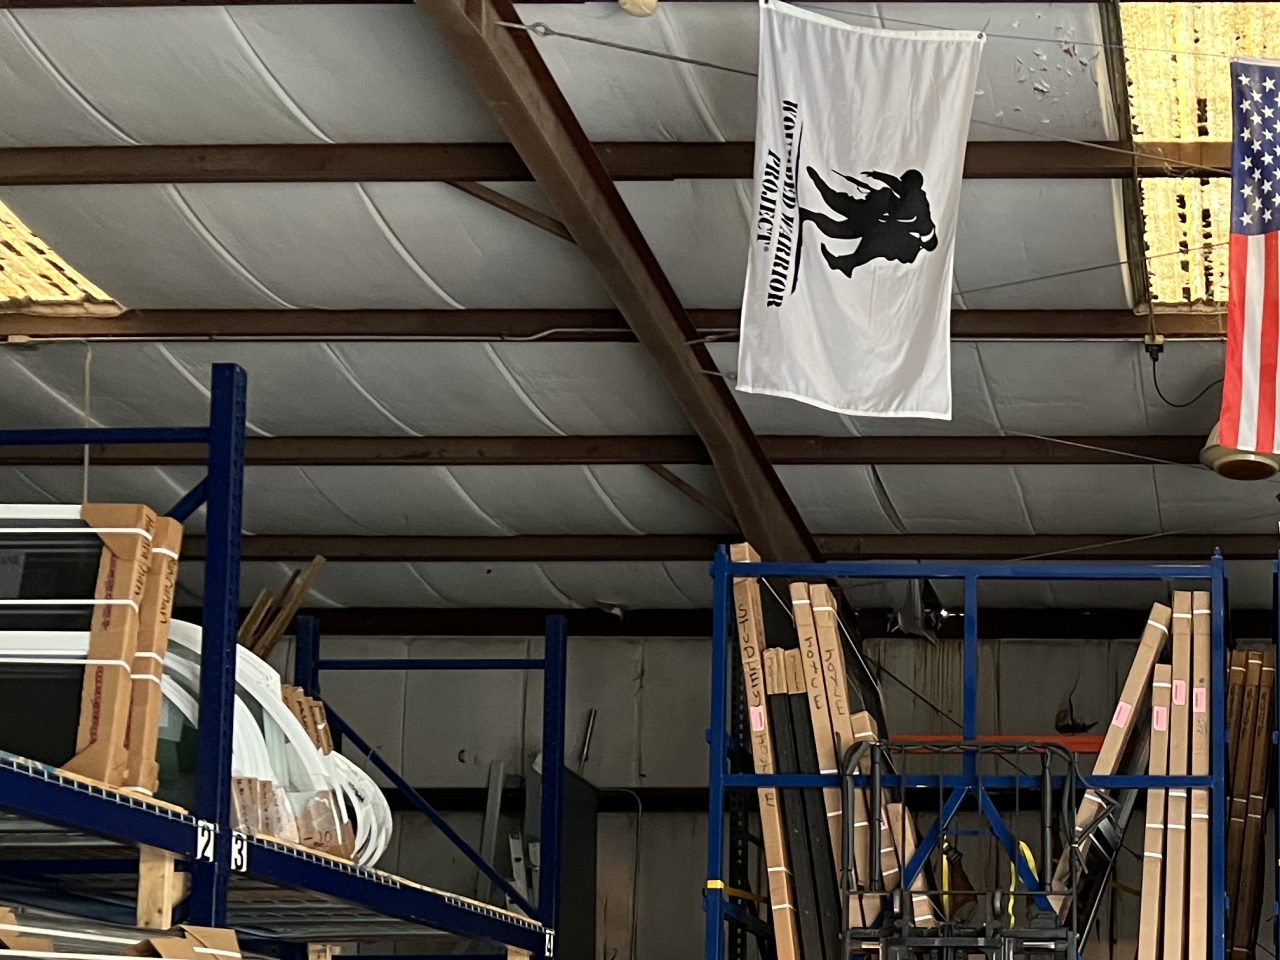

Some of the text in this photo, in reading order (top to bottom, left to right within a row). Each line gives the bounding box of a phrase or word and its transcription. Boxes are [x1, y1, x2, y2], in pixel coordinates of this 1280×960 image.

[757, 149, 781, 243] PROJECT
[767, 212, 794, 308] WARRIOR
[200, 828, 211, 861] 2
[233, 834, 244, 869] 3
[545, 934, 553, 956] 4
